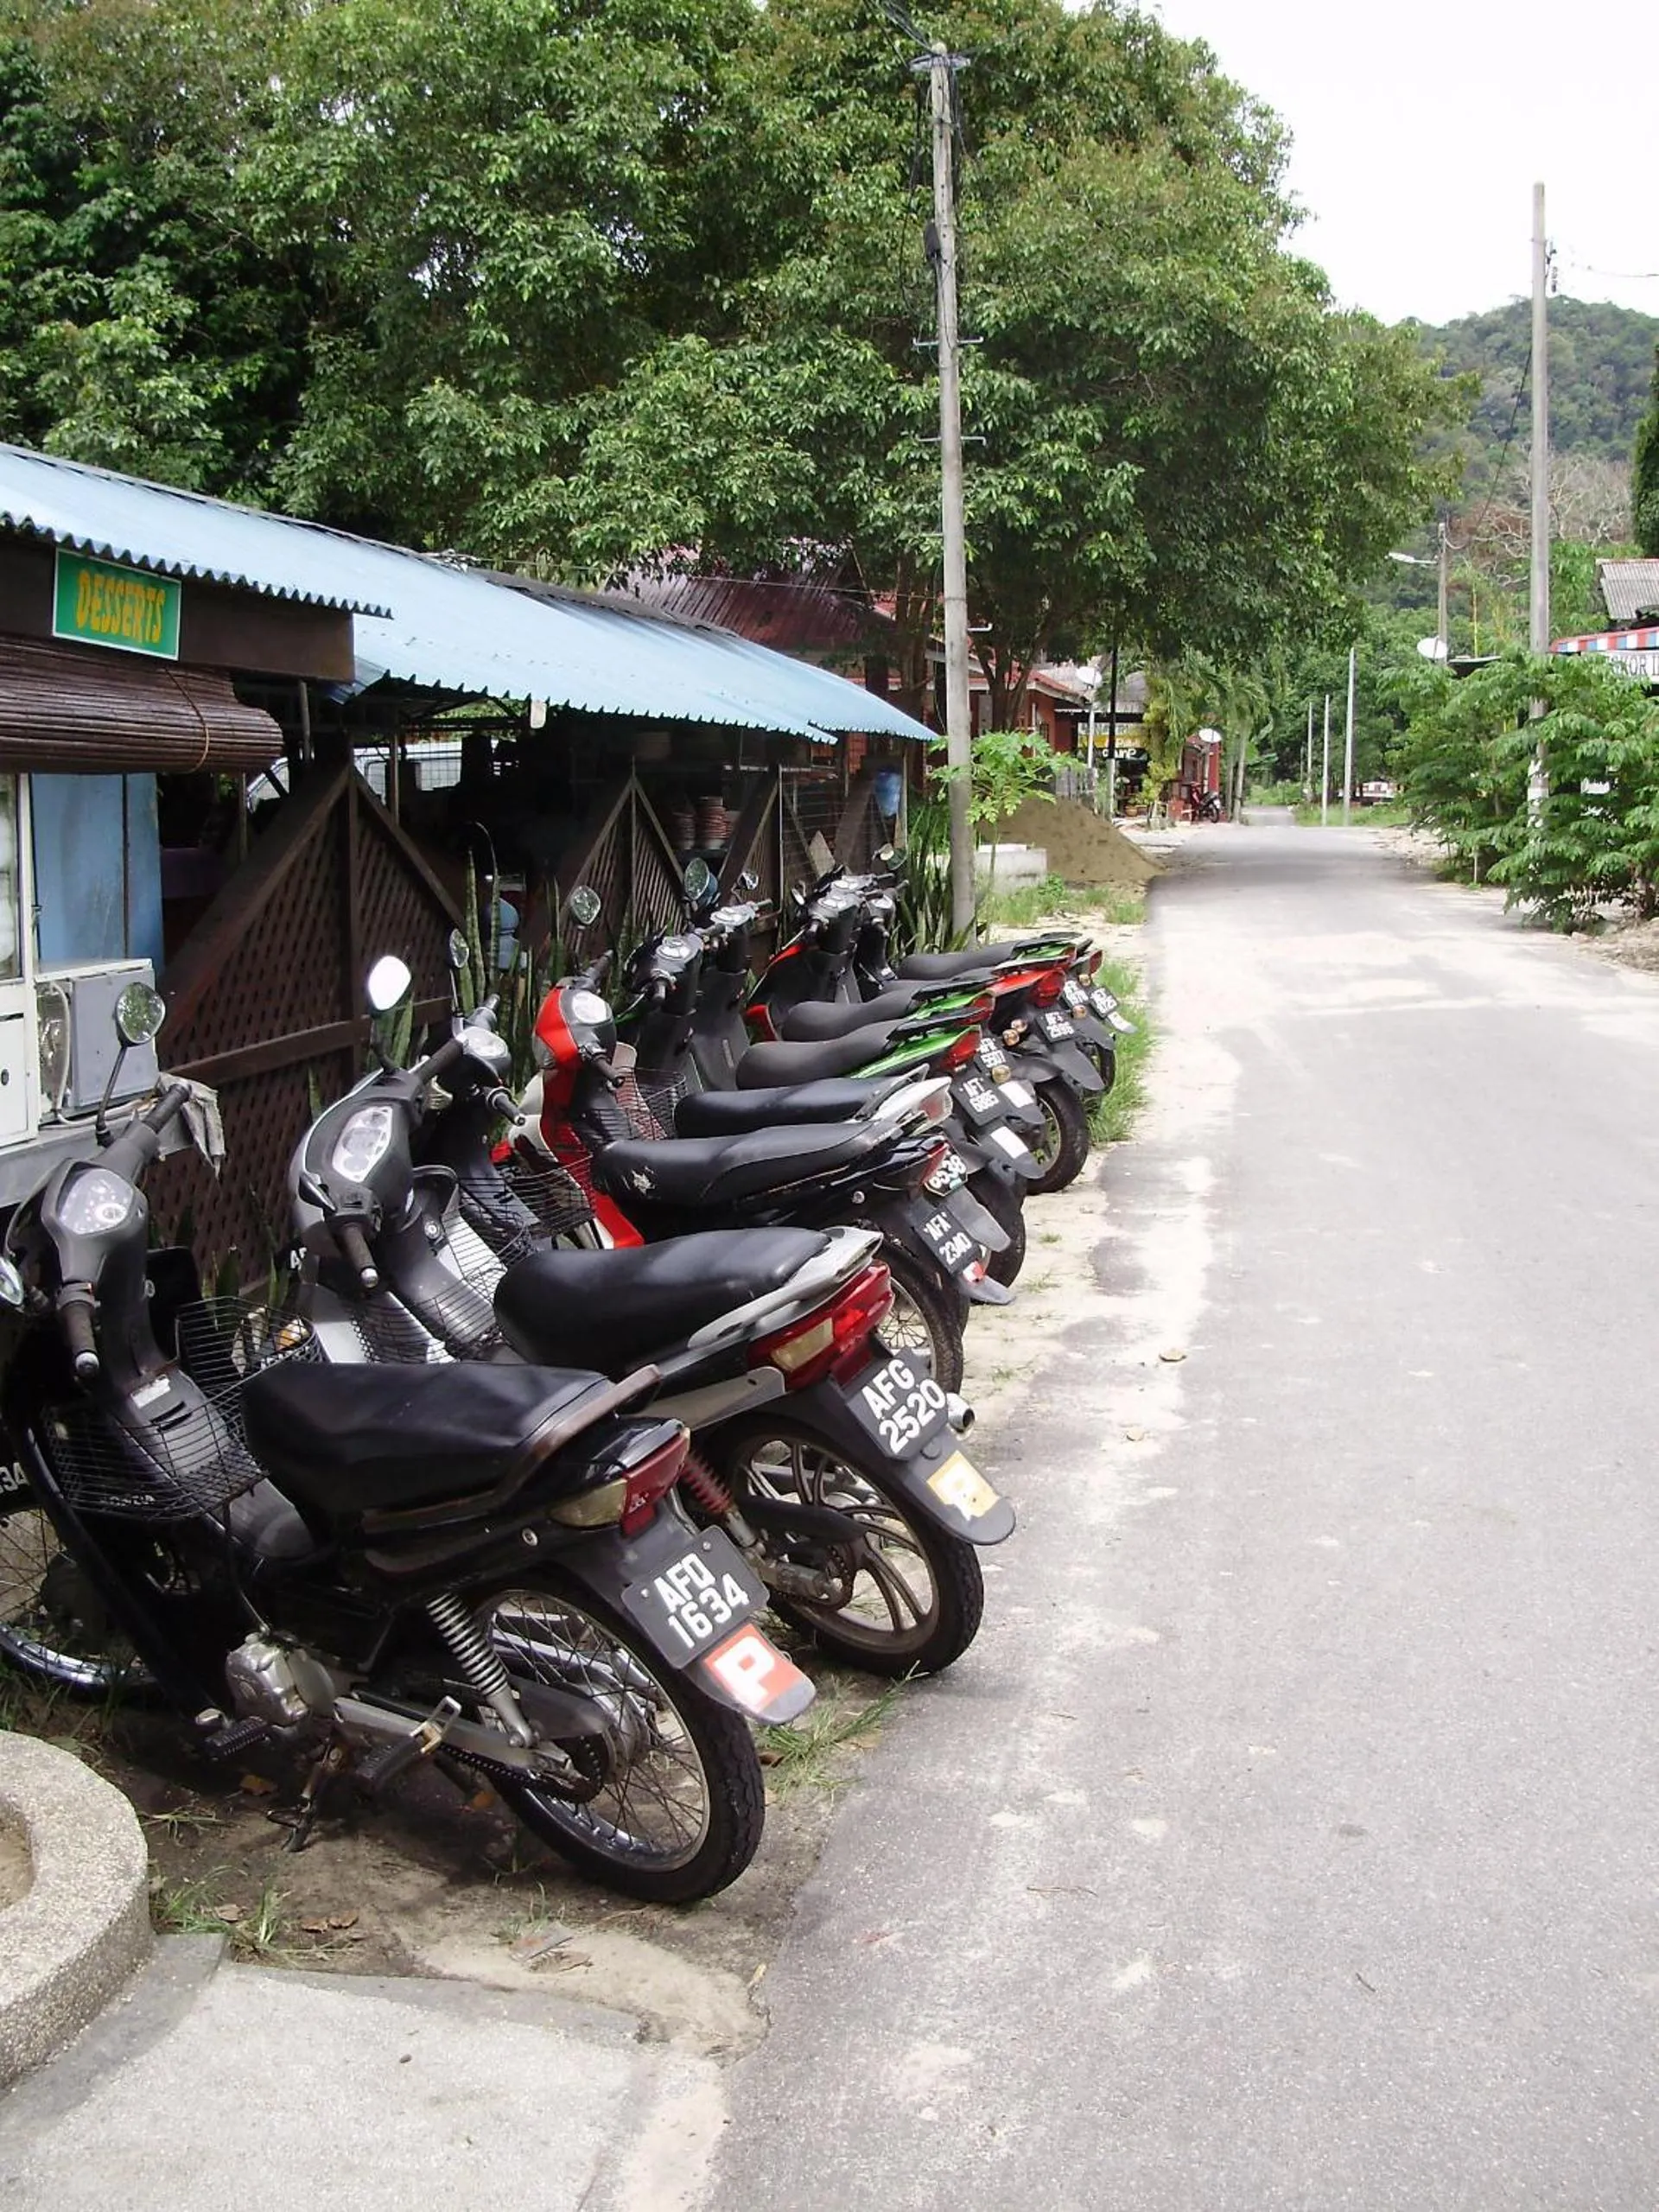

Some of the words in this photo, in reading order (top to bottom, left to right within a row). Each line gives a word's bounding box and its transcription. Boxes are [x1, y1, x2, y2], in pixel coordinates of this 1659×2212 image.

[77, 570, 165, 643] DESSERTS
[290, 1247, 308, 1271] AF
[939, 1232, 972, 1264] 2340
[861, 1359, 915, 1420] AFG
[880, 1378, 946, 1454] 2520
[0, 1462, 30, 1494] 34
[668, 1573, 749, 1649] 1634
[714, 1636, 775, 1713] P
